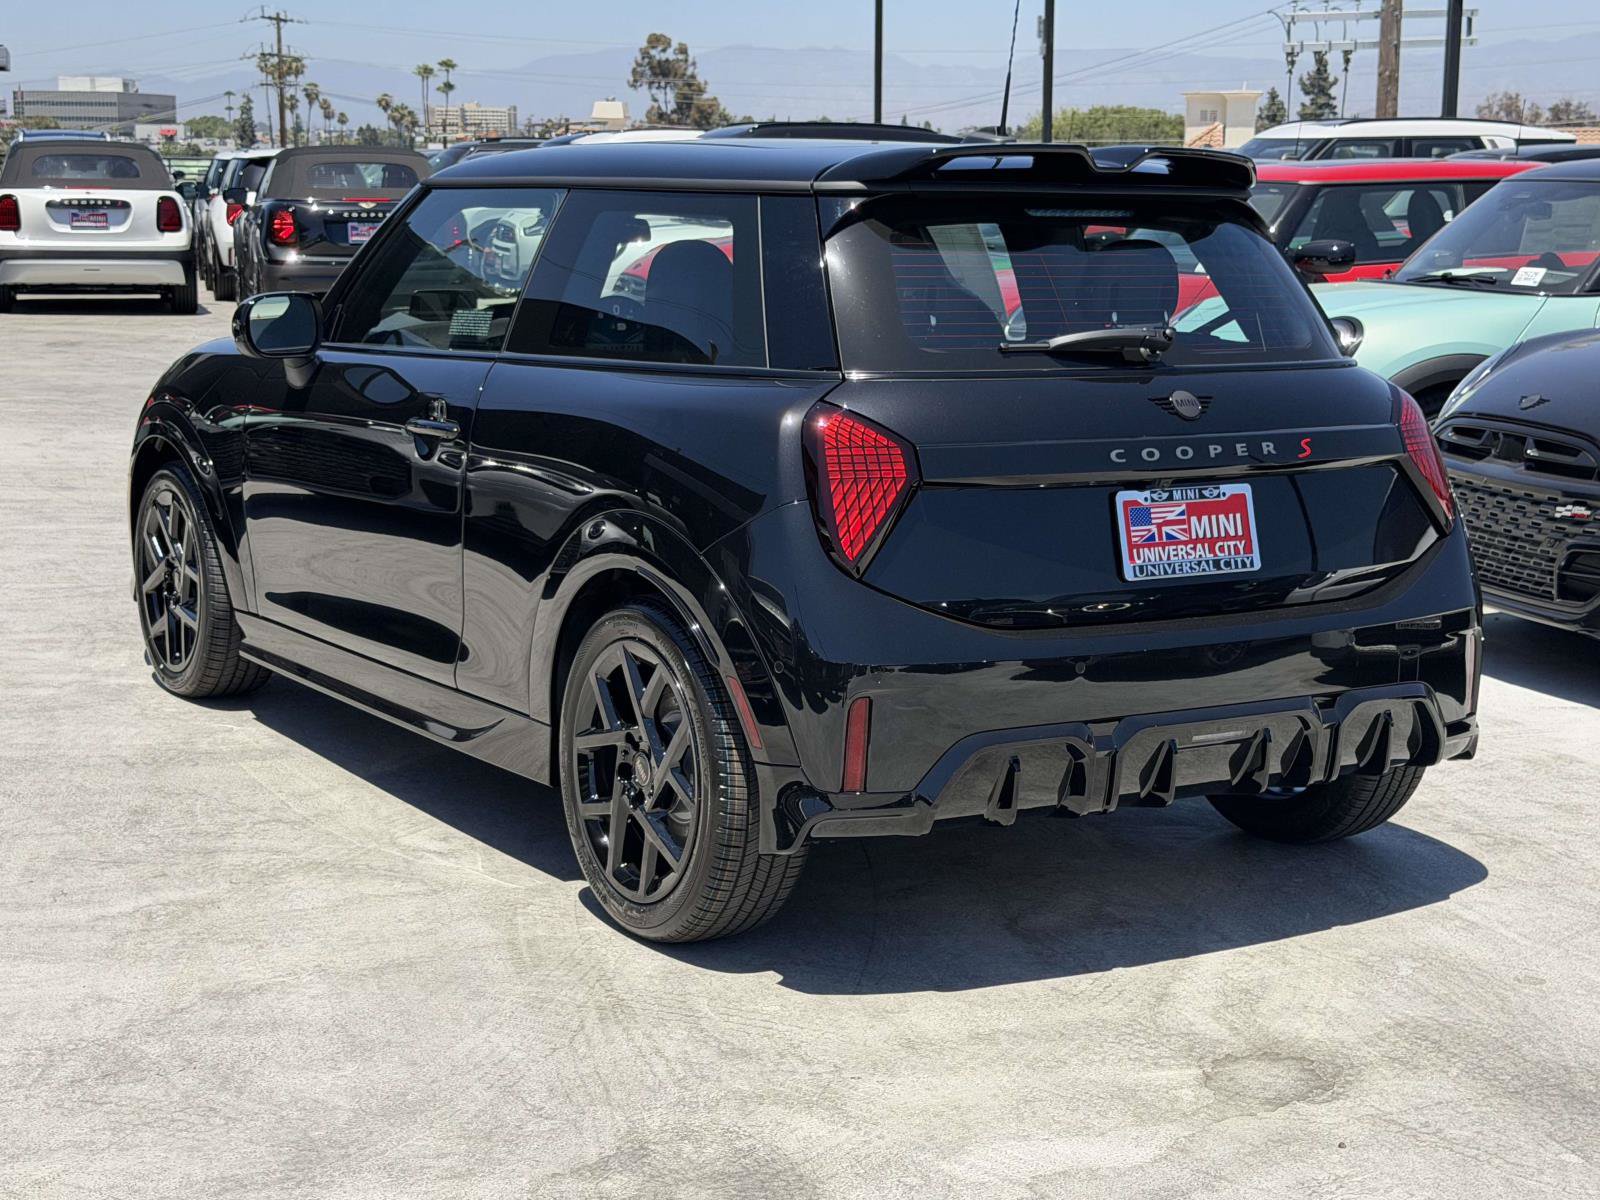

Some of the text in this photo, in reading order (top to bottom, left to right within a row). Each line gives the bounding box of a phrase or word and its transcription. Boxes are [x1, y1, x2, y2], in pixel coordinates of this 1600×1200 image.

[1175, 398, 1199, 410] MINI
[1110, 438, 1312, 463] COOPER S
[1172, 489, 1200, 501] MINI
[1190, 513, 1243, 540] MINI
[1132, 539, 1246, 564] UNIVERSAL CITY
[1134, 555, 1254, 578] UNIVERSAL CITY
[635, 759, 648, 782] MINI
